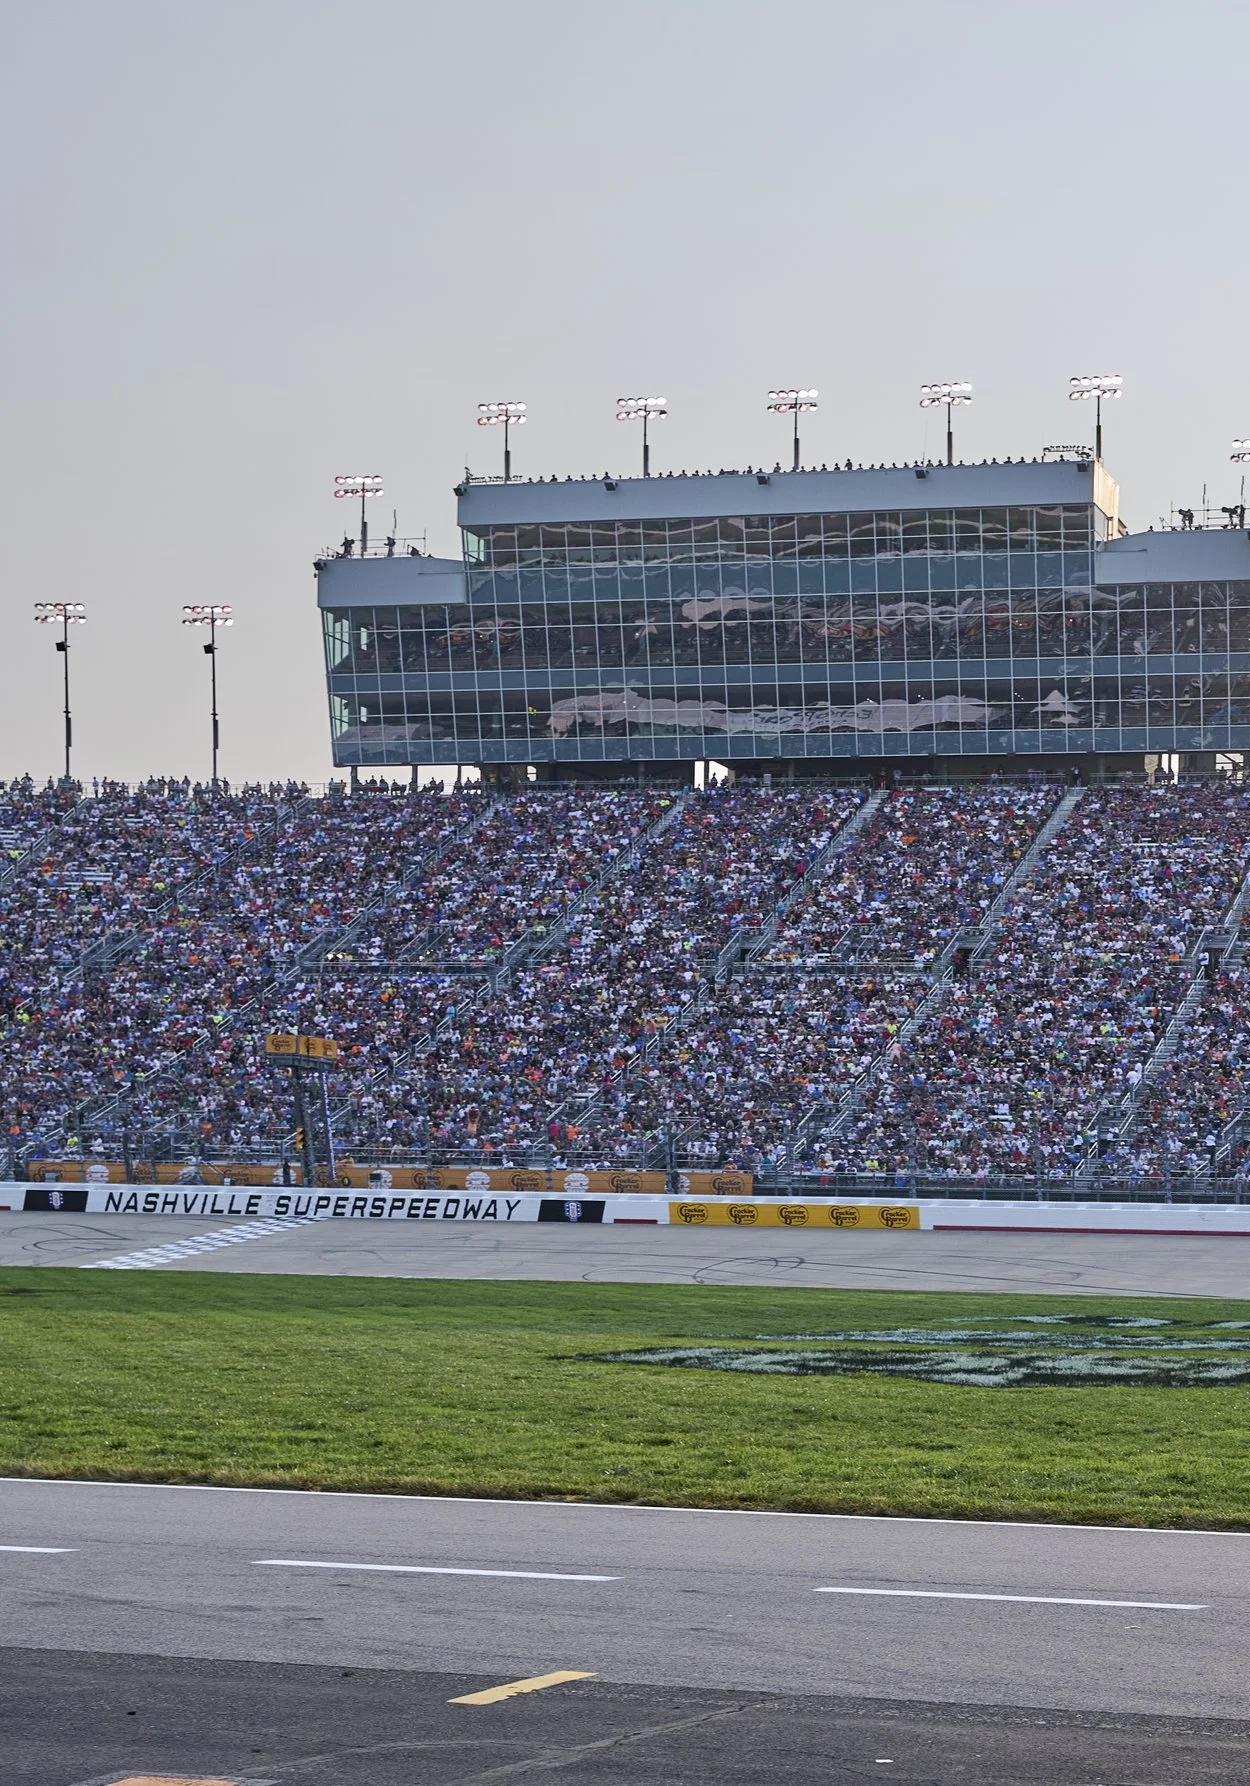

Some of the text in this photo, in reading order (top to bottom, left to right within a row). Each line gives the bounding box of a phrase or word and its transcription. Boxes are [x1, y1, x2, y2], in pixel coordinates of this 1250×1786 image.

[611, 1175, 638, 1186] Cracker
[712, 1176, 740, 1187] Cracker
[105, 1192, 521, 1220] NASHVILLE SUPERSPEEDWAY
[679, 1205, 705, 1217] Cracker
[729, 1206, 755, 1218] Cracker
[780, 1207, 806, 1219] Cracker
[831, 1208, 857, 1220] Cracker
[881, 1209, 907, 1221] Cracker
[684, 1213, 706, 1223] Barrel
[734, 1214, 756, 1224] Barrel
[784, 1214, 806, 1225] Barrel
[836, 1215, 858, 1226] Barrel
[886, 1216, 908, 1227] Barrel
